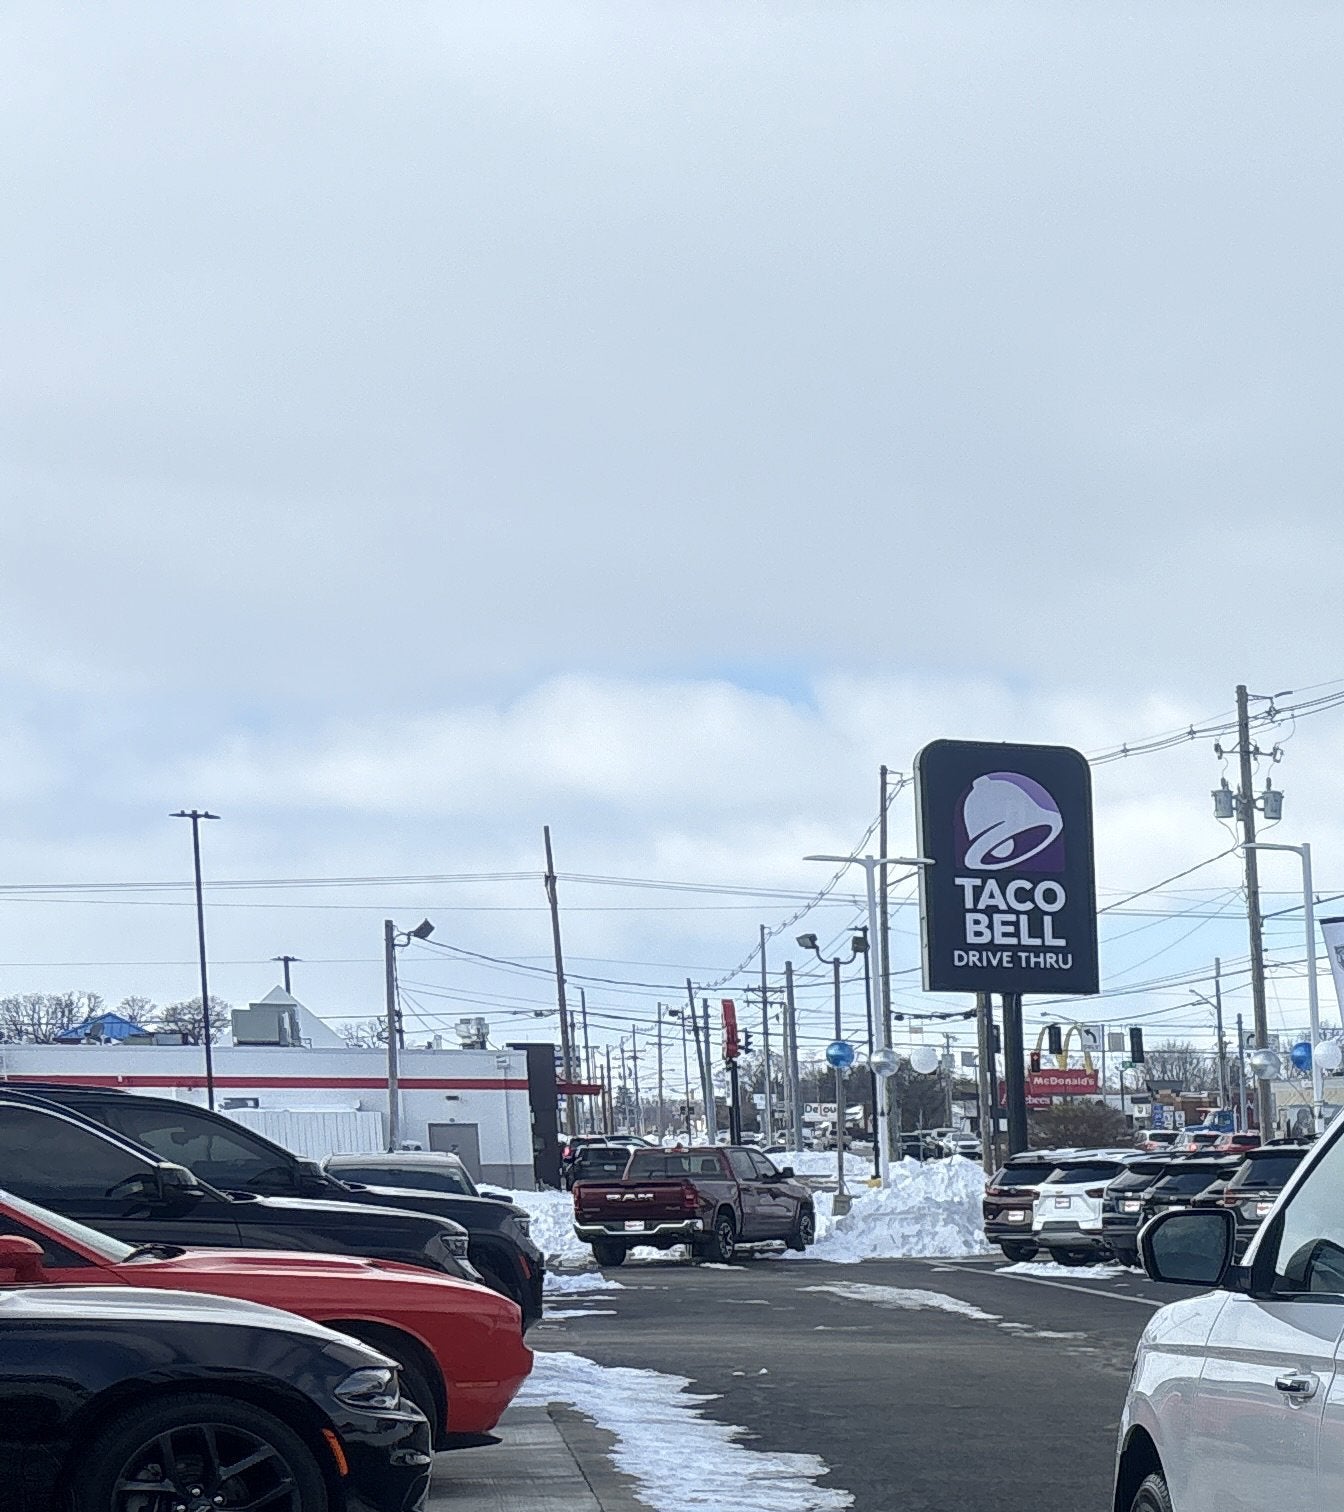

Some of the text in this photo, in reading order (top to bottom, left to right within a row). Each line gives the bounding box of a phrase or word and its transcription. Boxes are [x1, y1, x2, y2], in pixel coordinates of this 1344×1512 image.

[954, 877, 1066, 912] TACO
[965, 912, 1067, 946] BELL
[953, 950, 1073, 969] DRIVE THRU
[1033, 1076, 1095, 1086] McDonald's
[605, 1193, 655, 1201] RAM
